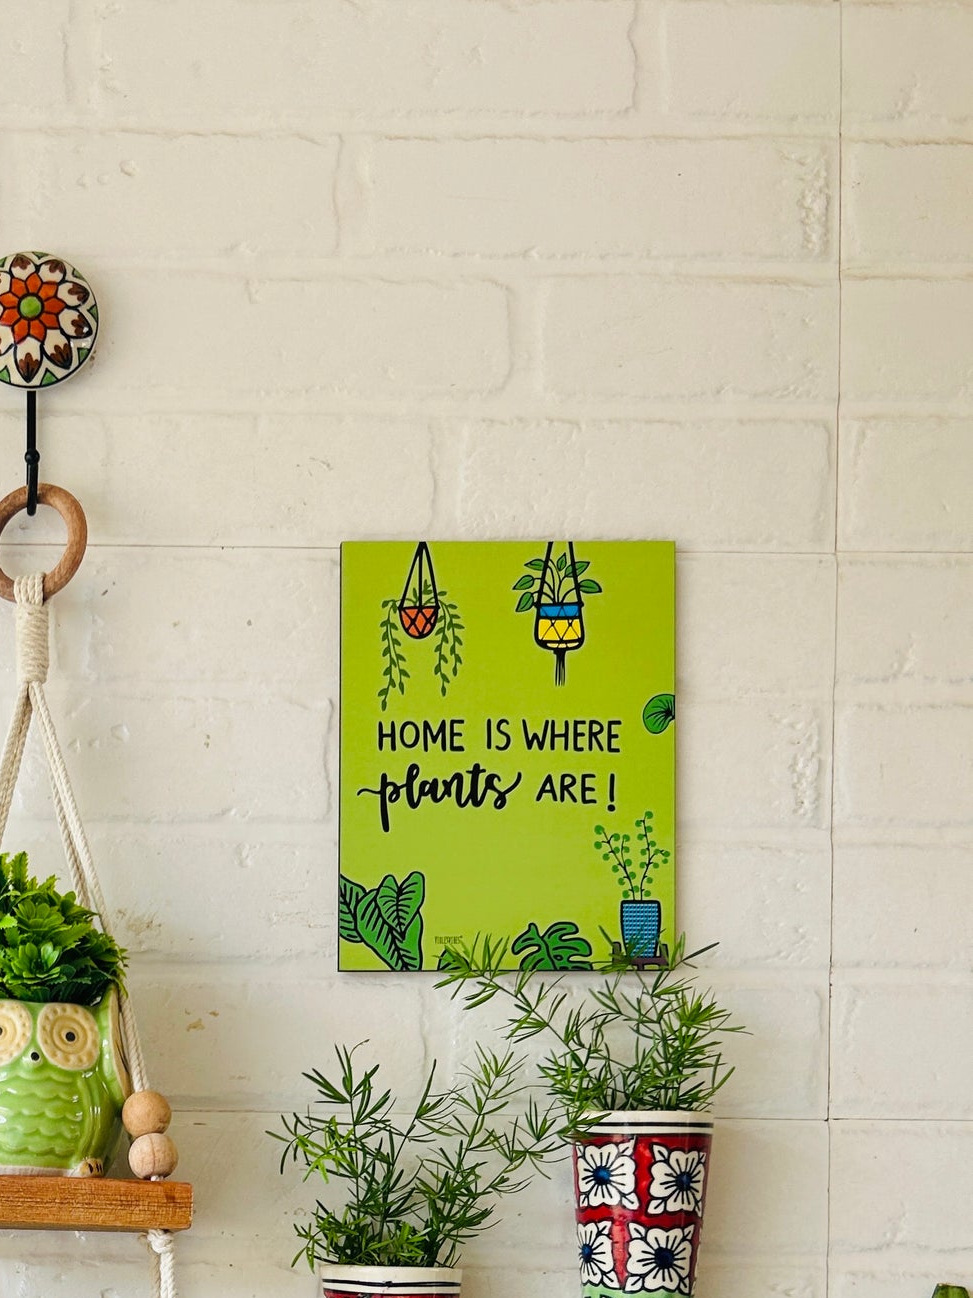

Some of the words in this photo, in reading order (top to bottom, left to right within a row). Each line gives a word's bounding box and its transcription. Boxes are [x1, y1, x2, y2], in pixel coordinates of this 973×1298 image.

[377, 718, 465, 753] HOME
[486, 718, 512, 752] IS
[521, 718, 623, 754] WHERE
[357, 762, 522, 833] plants
